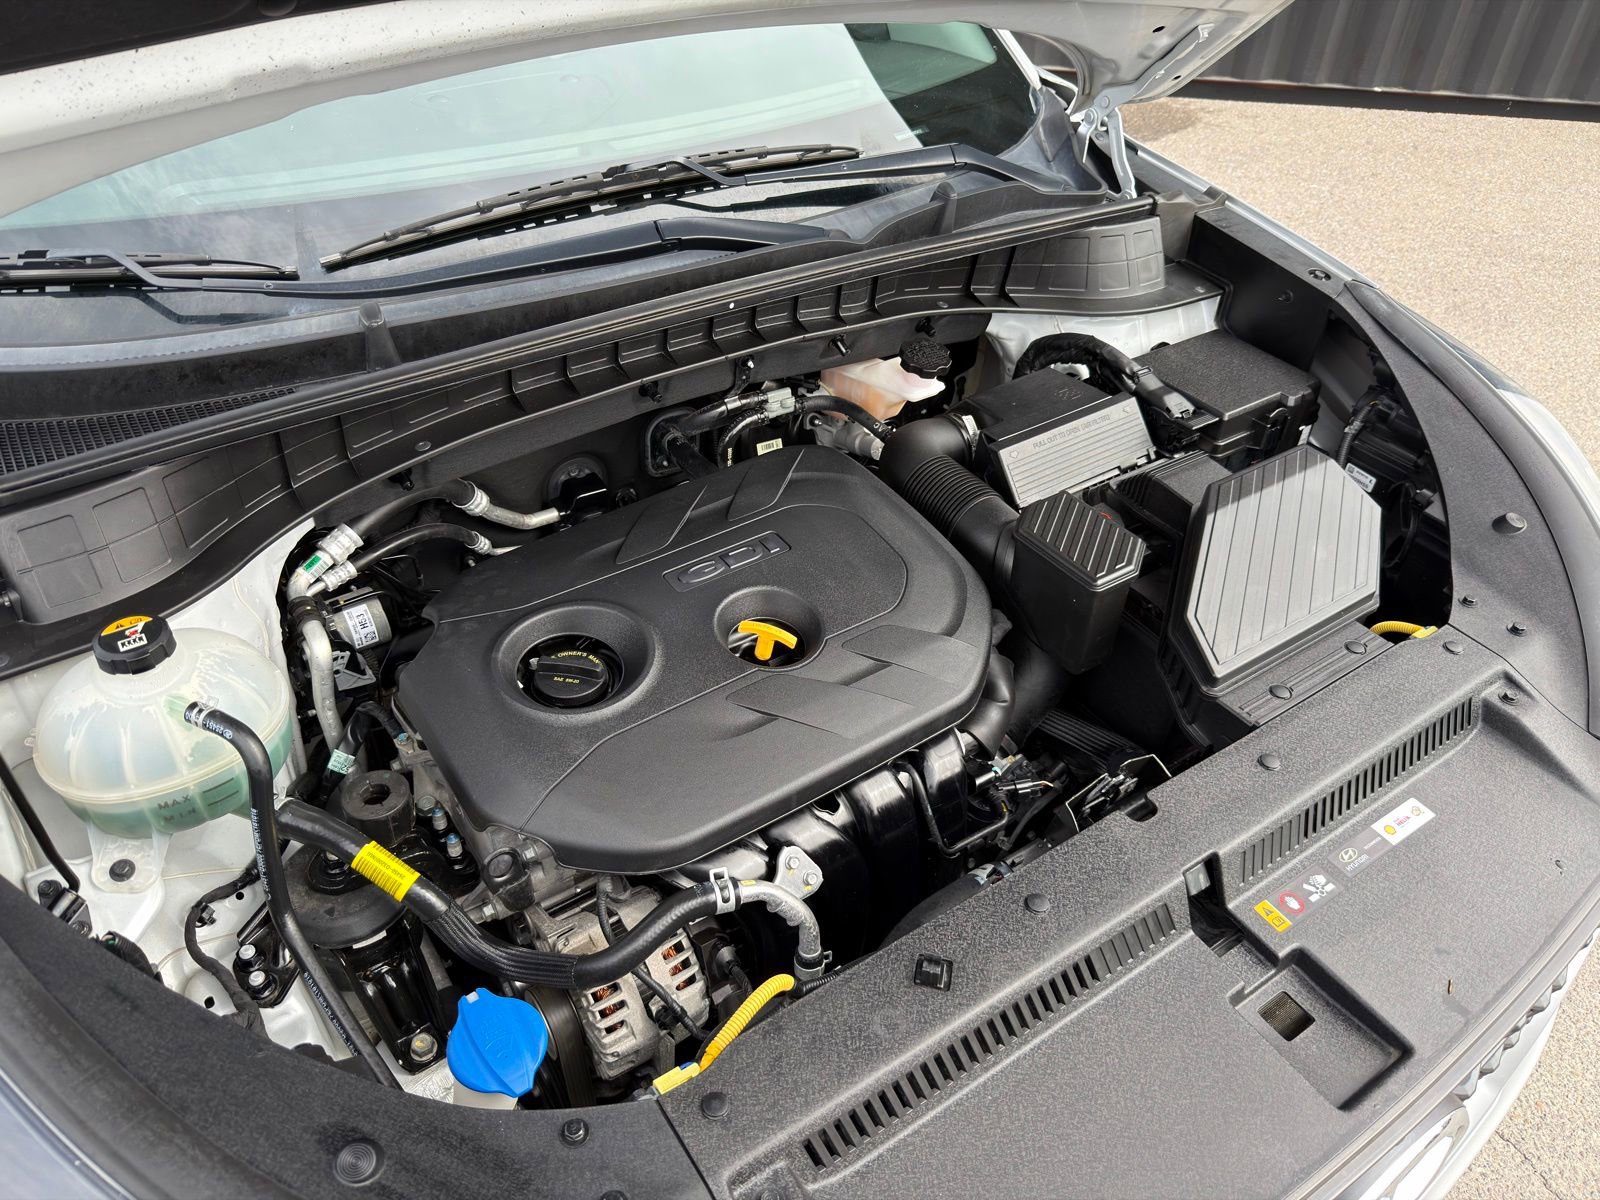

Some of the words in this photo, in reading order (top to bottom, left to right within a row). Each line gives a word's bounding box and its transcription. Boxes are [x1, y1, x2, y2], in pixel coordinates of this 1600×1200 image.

[1047, 434, 1059, 444] OUT
[677, 538, 781, 584] GDI
[355, 612, 370, 631] H53
[157, 794, 192, 810] MAX
[164, 807, 197, 823] MIN
[1345, 853, 1369, 872] HYUNDAI
